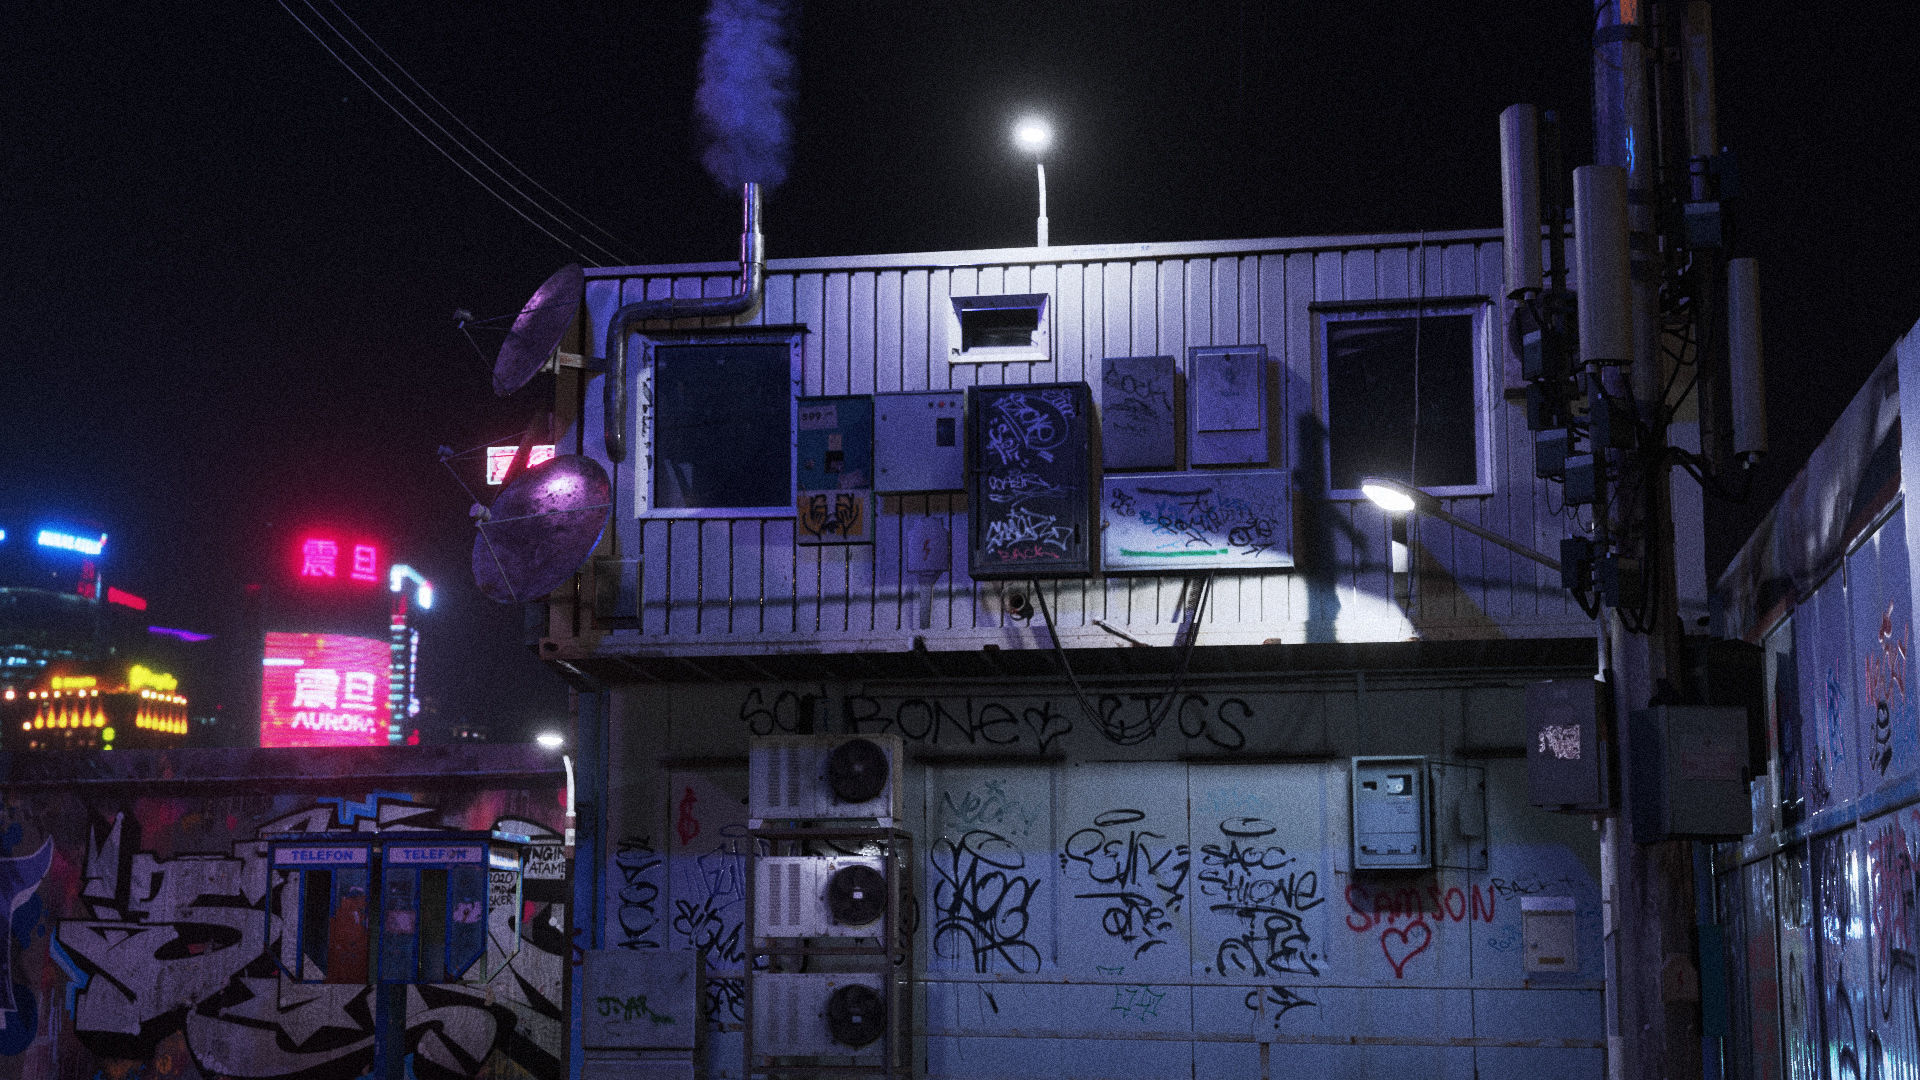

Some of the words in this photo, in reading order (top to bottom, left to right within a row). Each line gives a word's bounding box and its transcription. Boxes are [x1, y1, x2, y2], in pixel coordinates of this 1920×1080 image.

[302, 538, 378, 581] 震旦
[292, 668, 377, 709] 震旦
[291, 850, 354, 861] TELEFON
[1345, 884, 1494, 933] SAMSON
